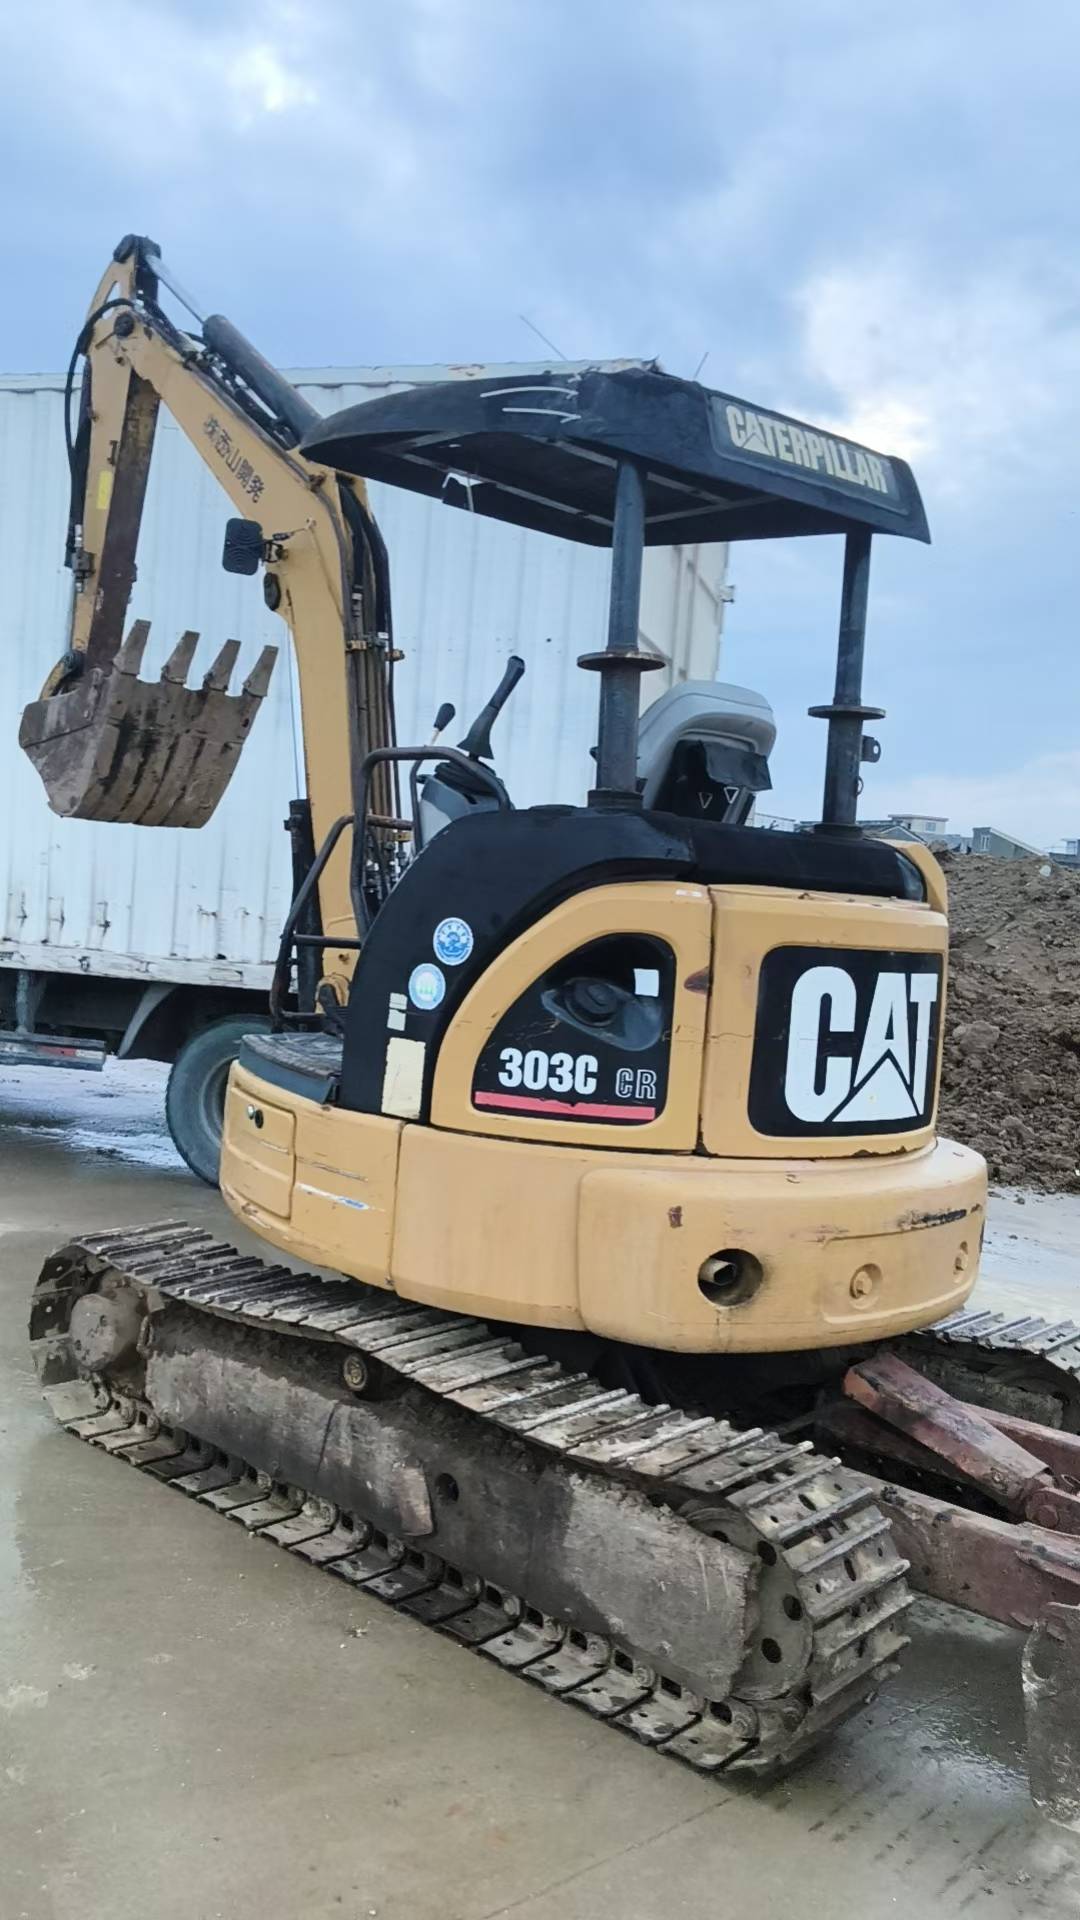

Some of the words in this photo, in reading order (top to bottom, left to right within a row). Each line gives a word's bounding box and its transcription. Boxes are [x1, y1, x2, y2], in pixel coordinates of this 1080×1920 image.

[725, 404, 889, 494] CATERPILLAR
[498, 1047, 599, 1095] 303C
[615, 1067, 657, 1099] CR
[784, 965, 939, 1123] CAT
